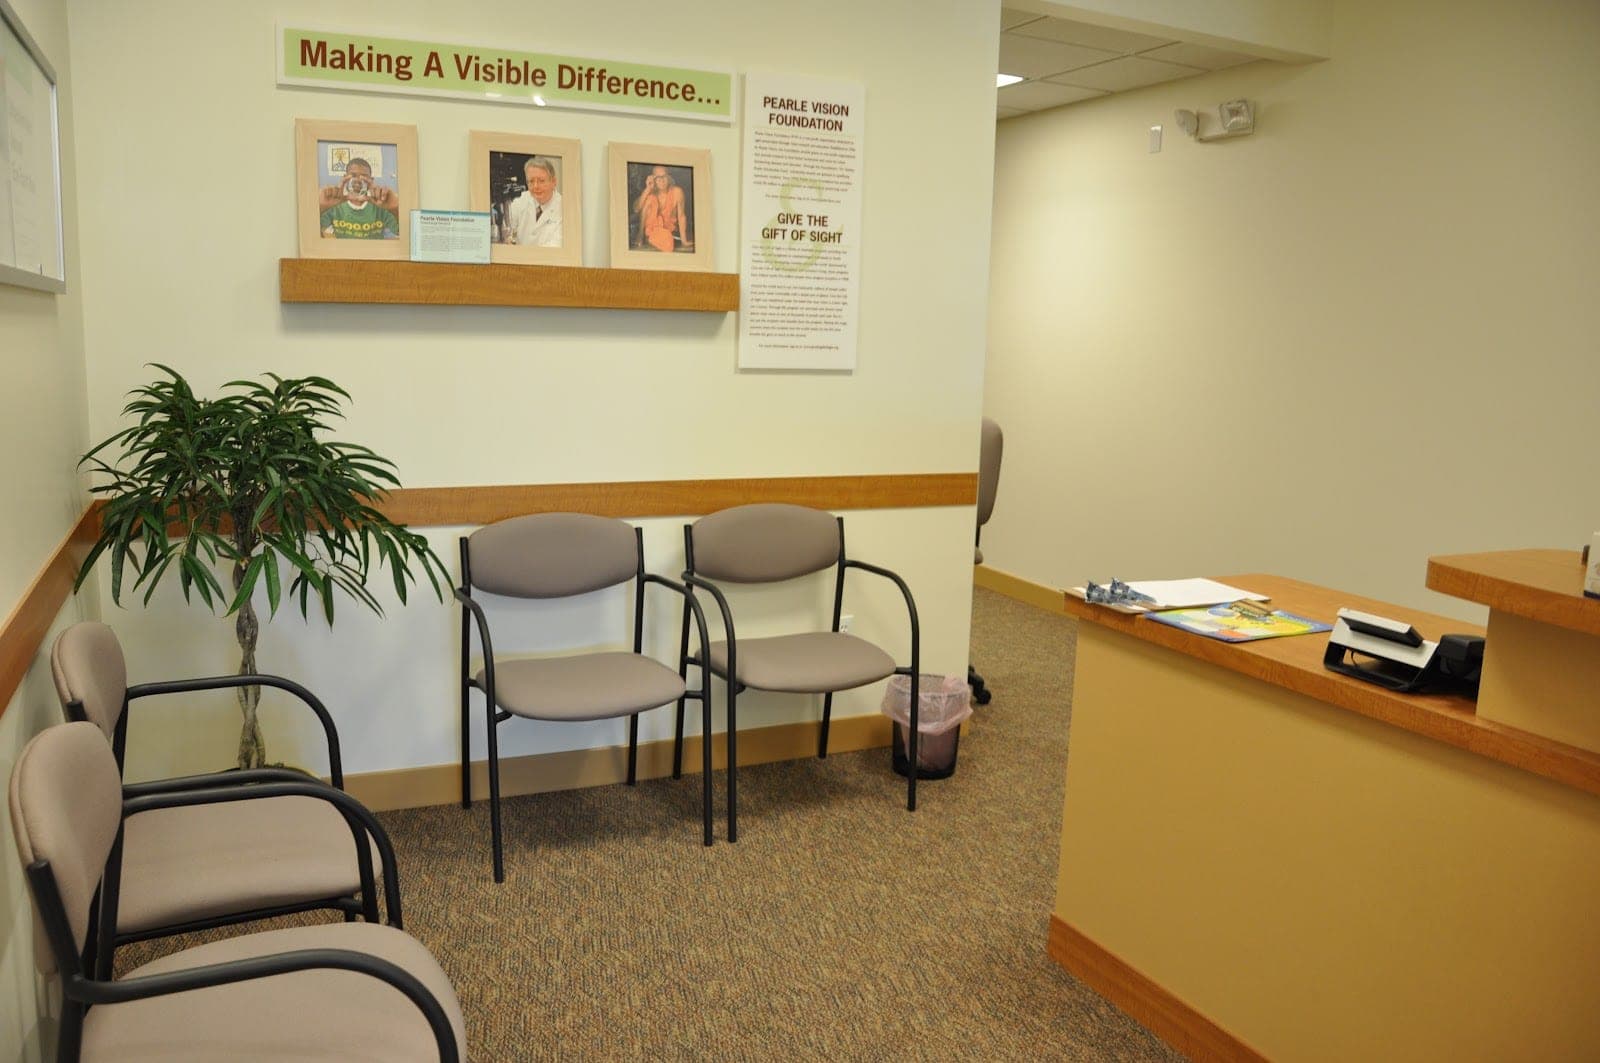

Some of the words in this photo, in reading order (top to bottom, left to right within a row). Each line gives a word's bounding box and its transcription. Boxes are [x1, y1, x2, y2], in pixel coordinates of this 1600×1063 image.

[300, 39, 413, 81] Making
[423, 51, 444, 79] A
[453, 53, 547, 87] Visible
[558, 63, 721, 105] Difference...
[763, 96, 808, 112] PEARLE
[812, 102, 849, 117] VISION
[769, 113, 842, 131] FOUNDATION
[777, 213, 803, 225] GIVE
[807, 215, 829, 227] THE
[761, 228, 787, 240] GIFT
[791, 230, 806, 241] OF
[810, 231, 843, 244] SIGHT
